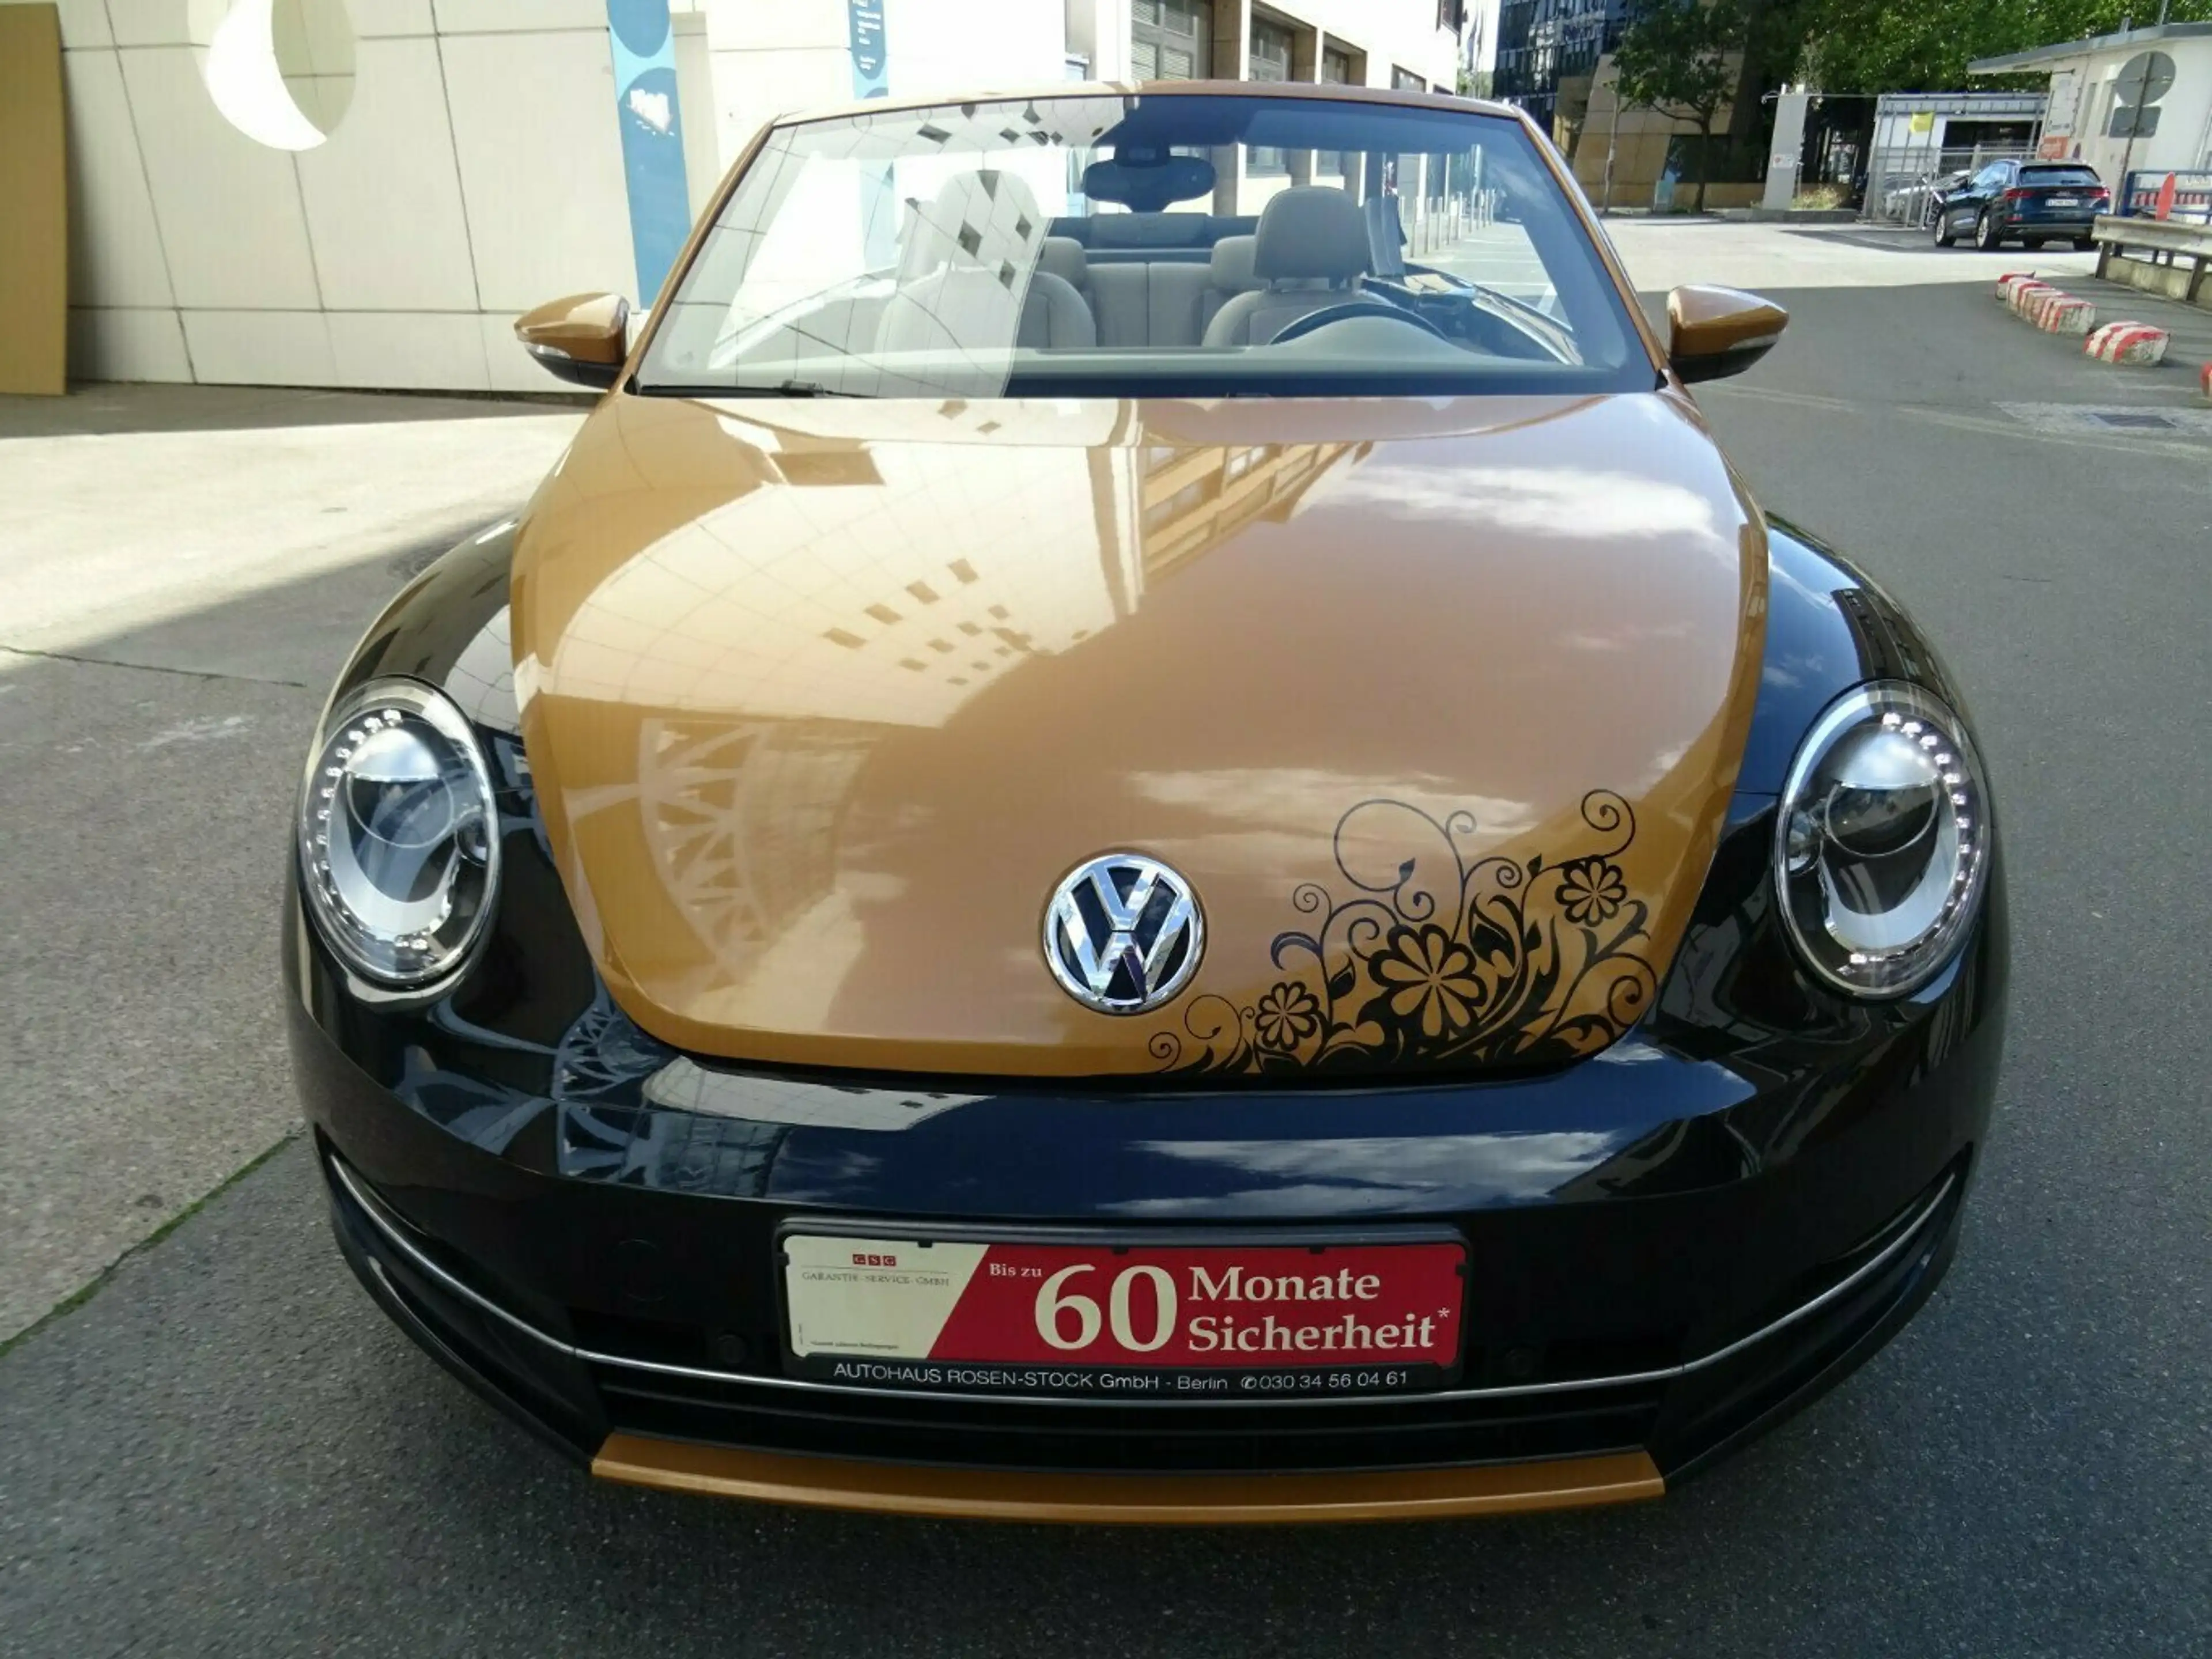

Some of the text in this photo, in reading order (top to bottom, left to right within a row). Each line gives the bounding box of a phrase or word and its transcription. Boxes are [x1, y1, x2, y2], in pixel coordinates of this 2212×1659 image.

[989, 1263, 1042, 1278] Bis zu
[1188, 1267, 1381, 1301] Monate
[1035, 1263, 1178, 1352] 60
[833, 1363, 941, 1383] AUTOHAUS
[947, 1370, 1094, 1387] ROSEN-STOCK
[1099, 1373, 1159, 1389] GmbH
[1177, 1376, 1228, 1389] Berlin
[1299, 1375, 1321, 1388] 34
[1328, 1373, 1351, 1388] 56
[1356, 1372, 1380, 1387] 04
[1385, 1371, 1408, 1385] 61
